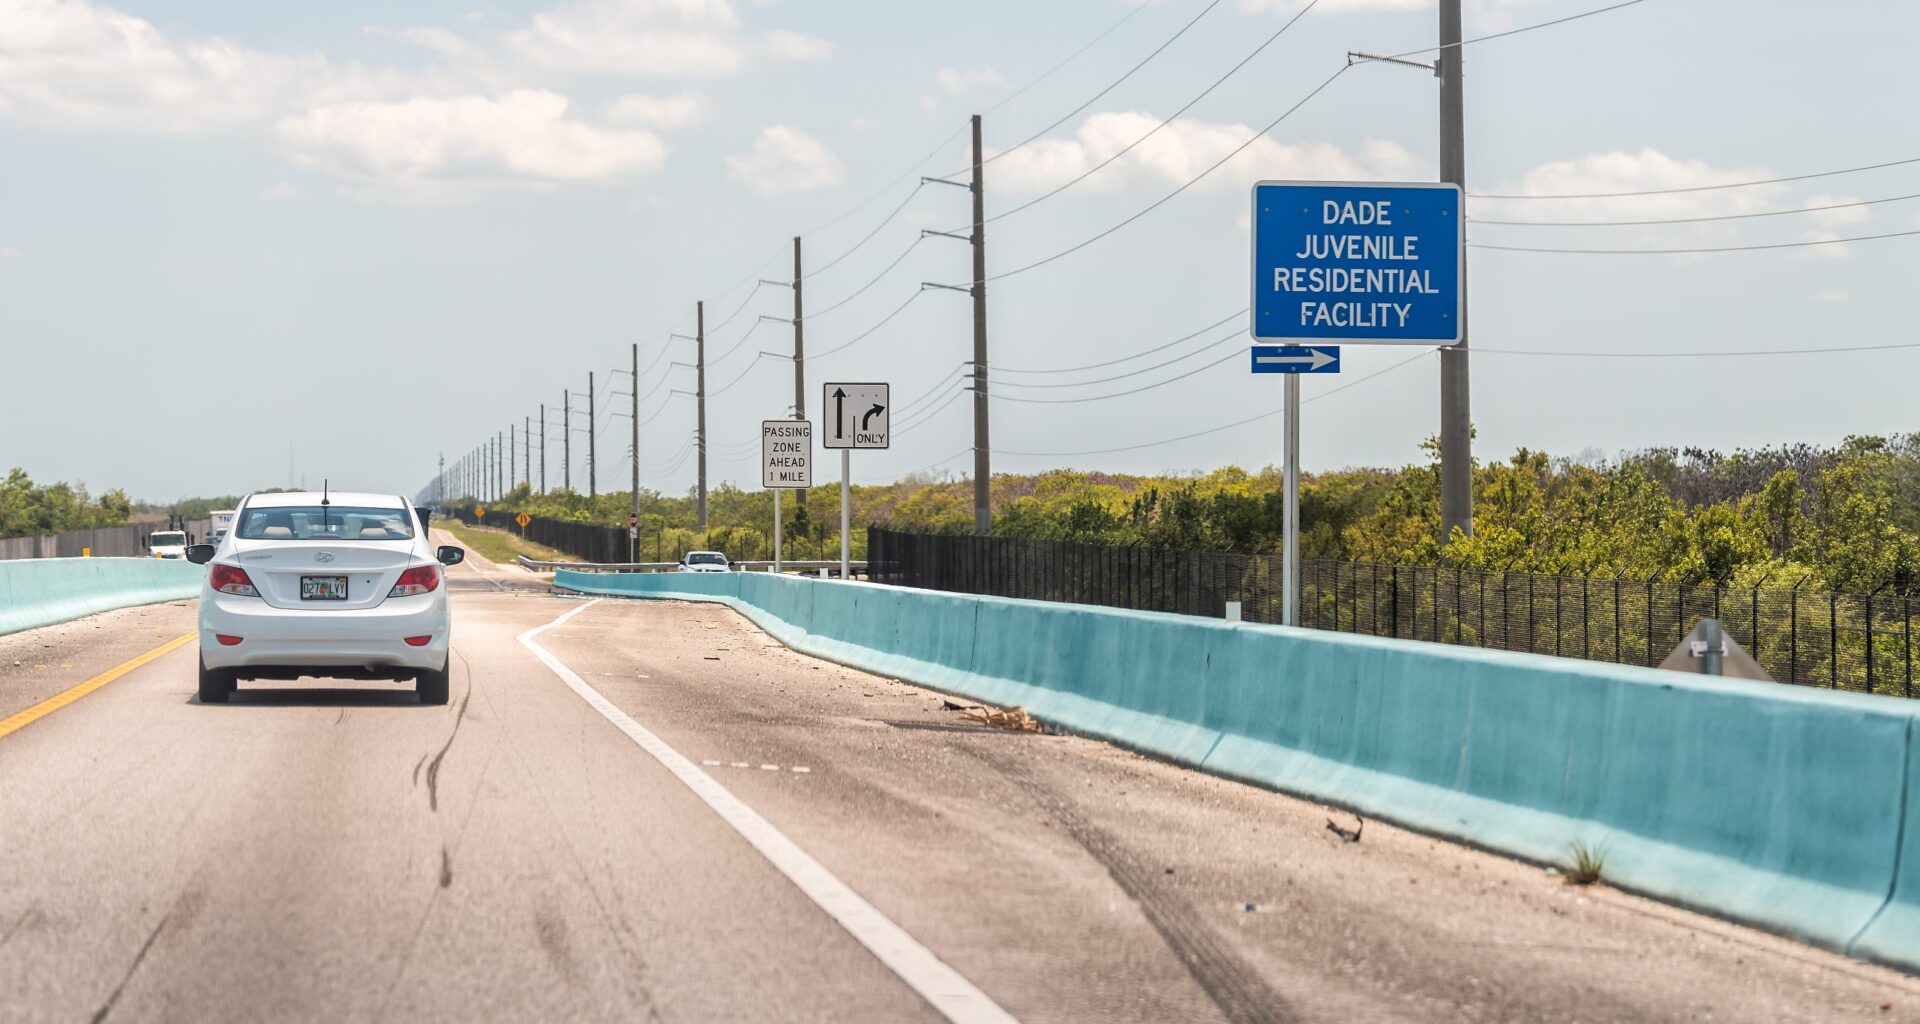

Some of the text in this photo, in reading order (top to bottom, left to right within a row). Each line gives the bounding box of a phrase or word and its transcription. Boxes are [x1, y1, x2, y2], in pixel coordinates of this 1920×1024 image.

[1323, 200, 1392, 225] DADE
[1296, 235, 1419, 260] JUVENILE
[1274, 267, 1439, 294] RESIDENTIAL
[1300, 301, 1412, 327] FACILITY
[764, 427, 810, 437] PASSING
[856, 433, 885, 444] ONLY
[772, 442, 801, 452] ZONE
[769, 457, 805, 467] AHEAD
[769, 472, 805, 482] 1 MILE
